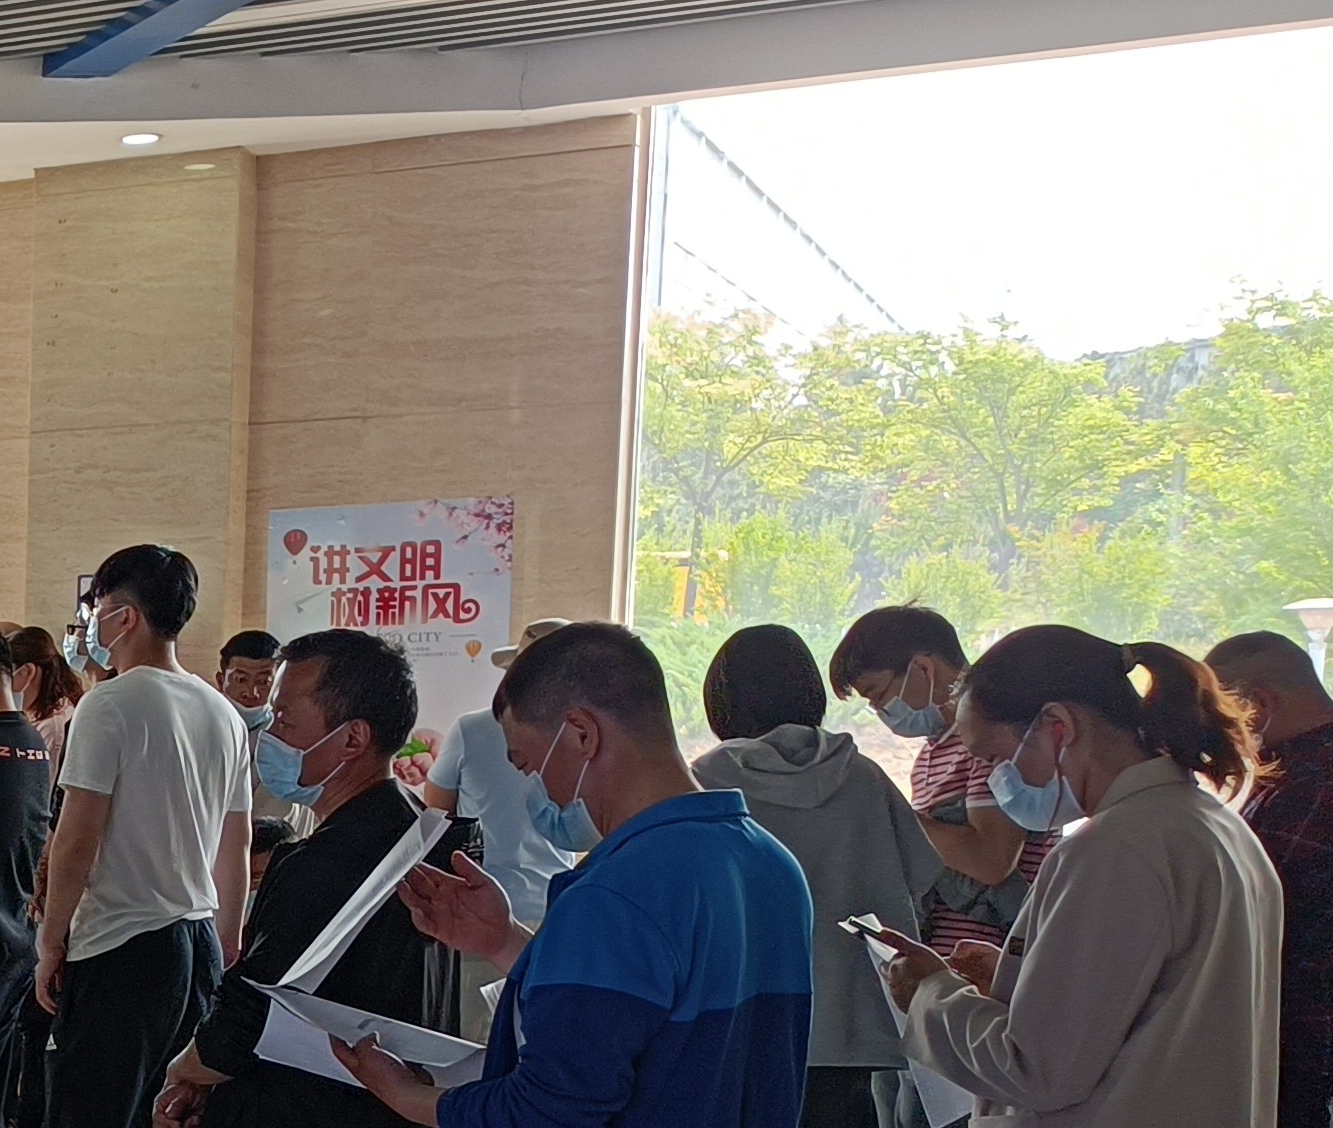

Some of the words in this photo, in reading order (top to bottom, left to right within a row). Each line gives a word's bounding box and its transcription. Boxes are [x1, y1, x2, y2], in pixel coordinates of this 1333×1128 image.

[309, 539, 442, 586] 讲文明
[330, 582, 481, 628] 树新风
[407, 631, 442, 643] CITY
